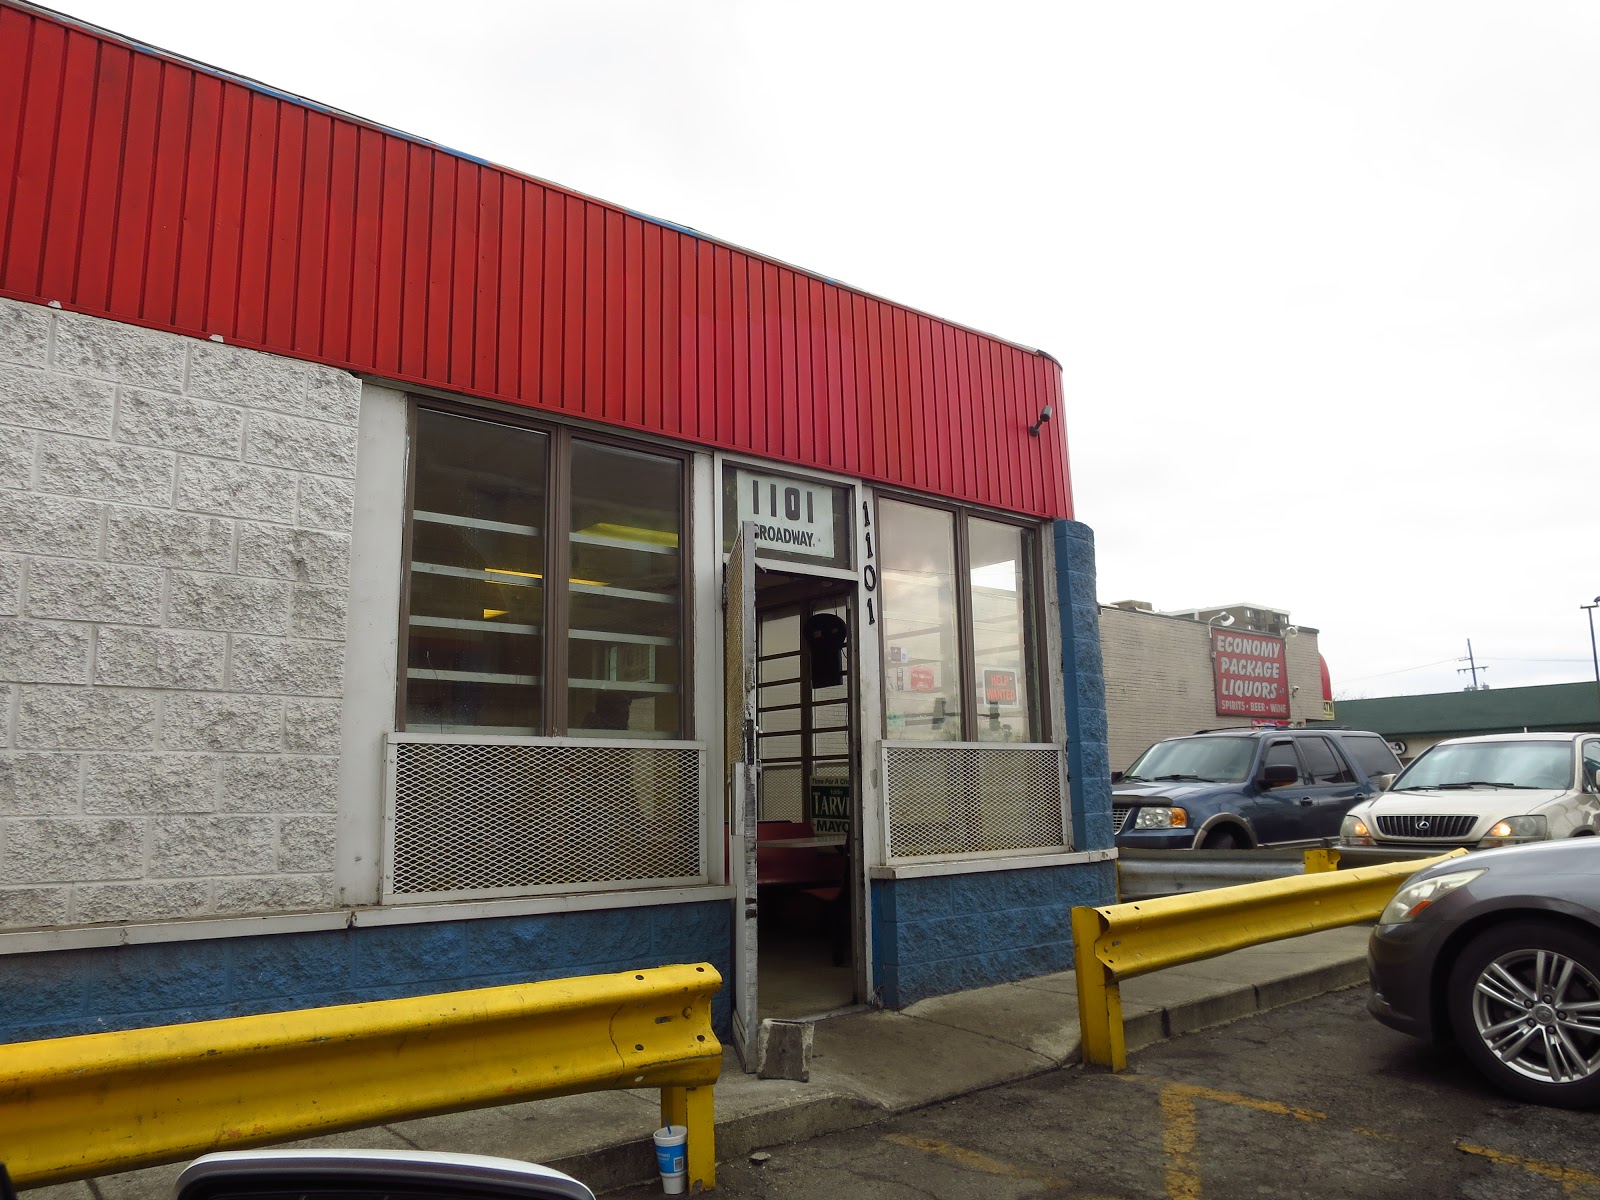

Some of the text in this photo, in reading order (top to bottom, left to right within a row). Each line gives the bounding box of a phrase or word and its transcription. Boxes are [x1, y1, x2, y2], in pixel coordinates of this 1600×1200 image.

[752, 480, 814, 524] 1101
[863, 501, 877, 625] 1101
[1216, 635, 1281, 658] ECONOMY
[1220, 657, 1280, 679] PACKAGE
[991, 674, 1009, 687] HELP
[1221, 678, 1278, 700] LIQUORS
[986, 688, 1016, 701] WANTED
[1221, 700, 1287, 714] SPIRITS BEER WINE
